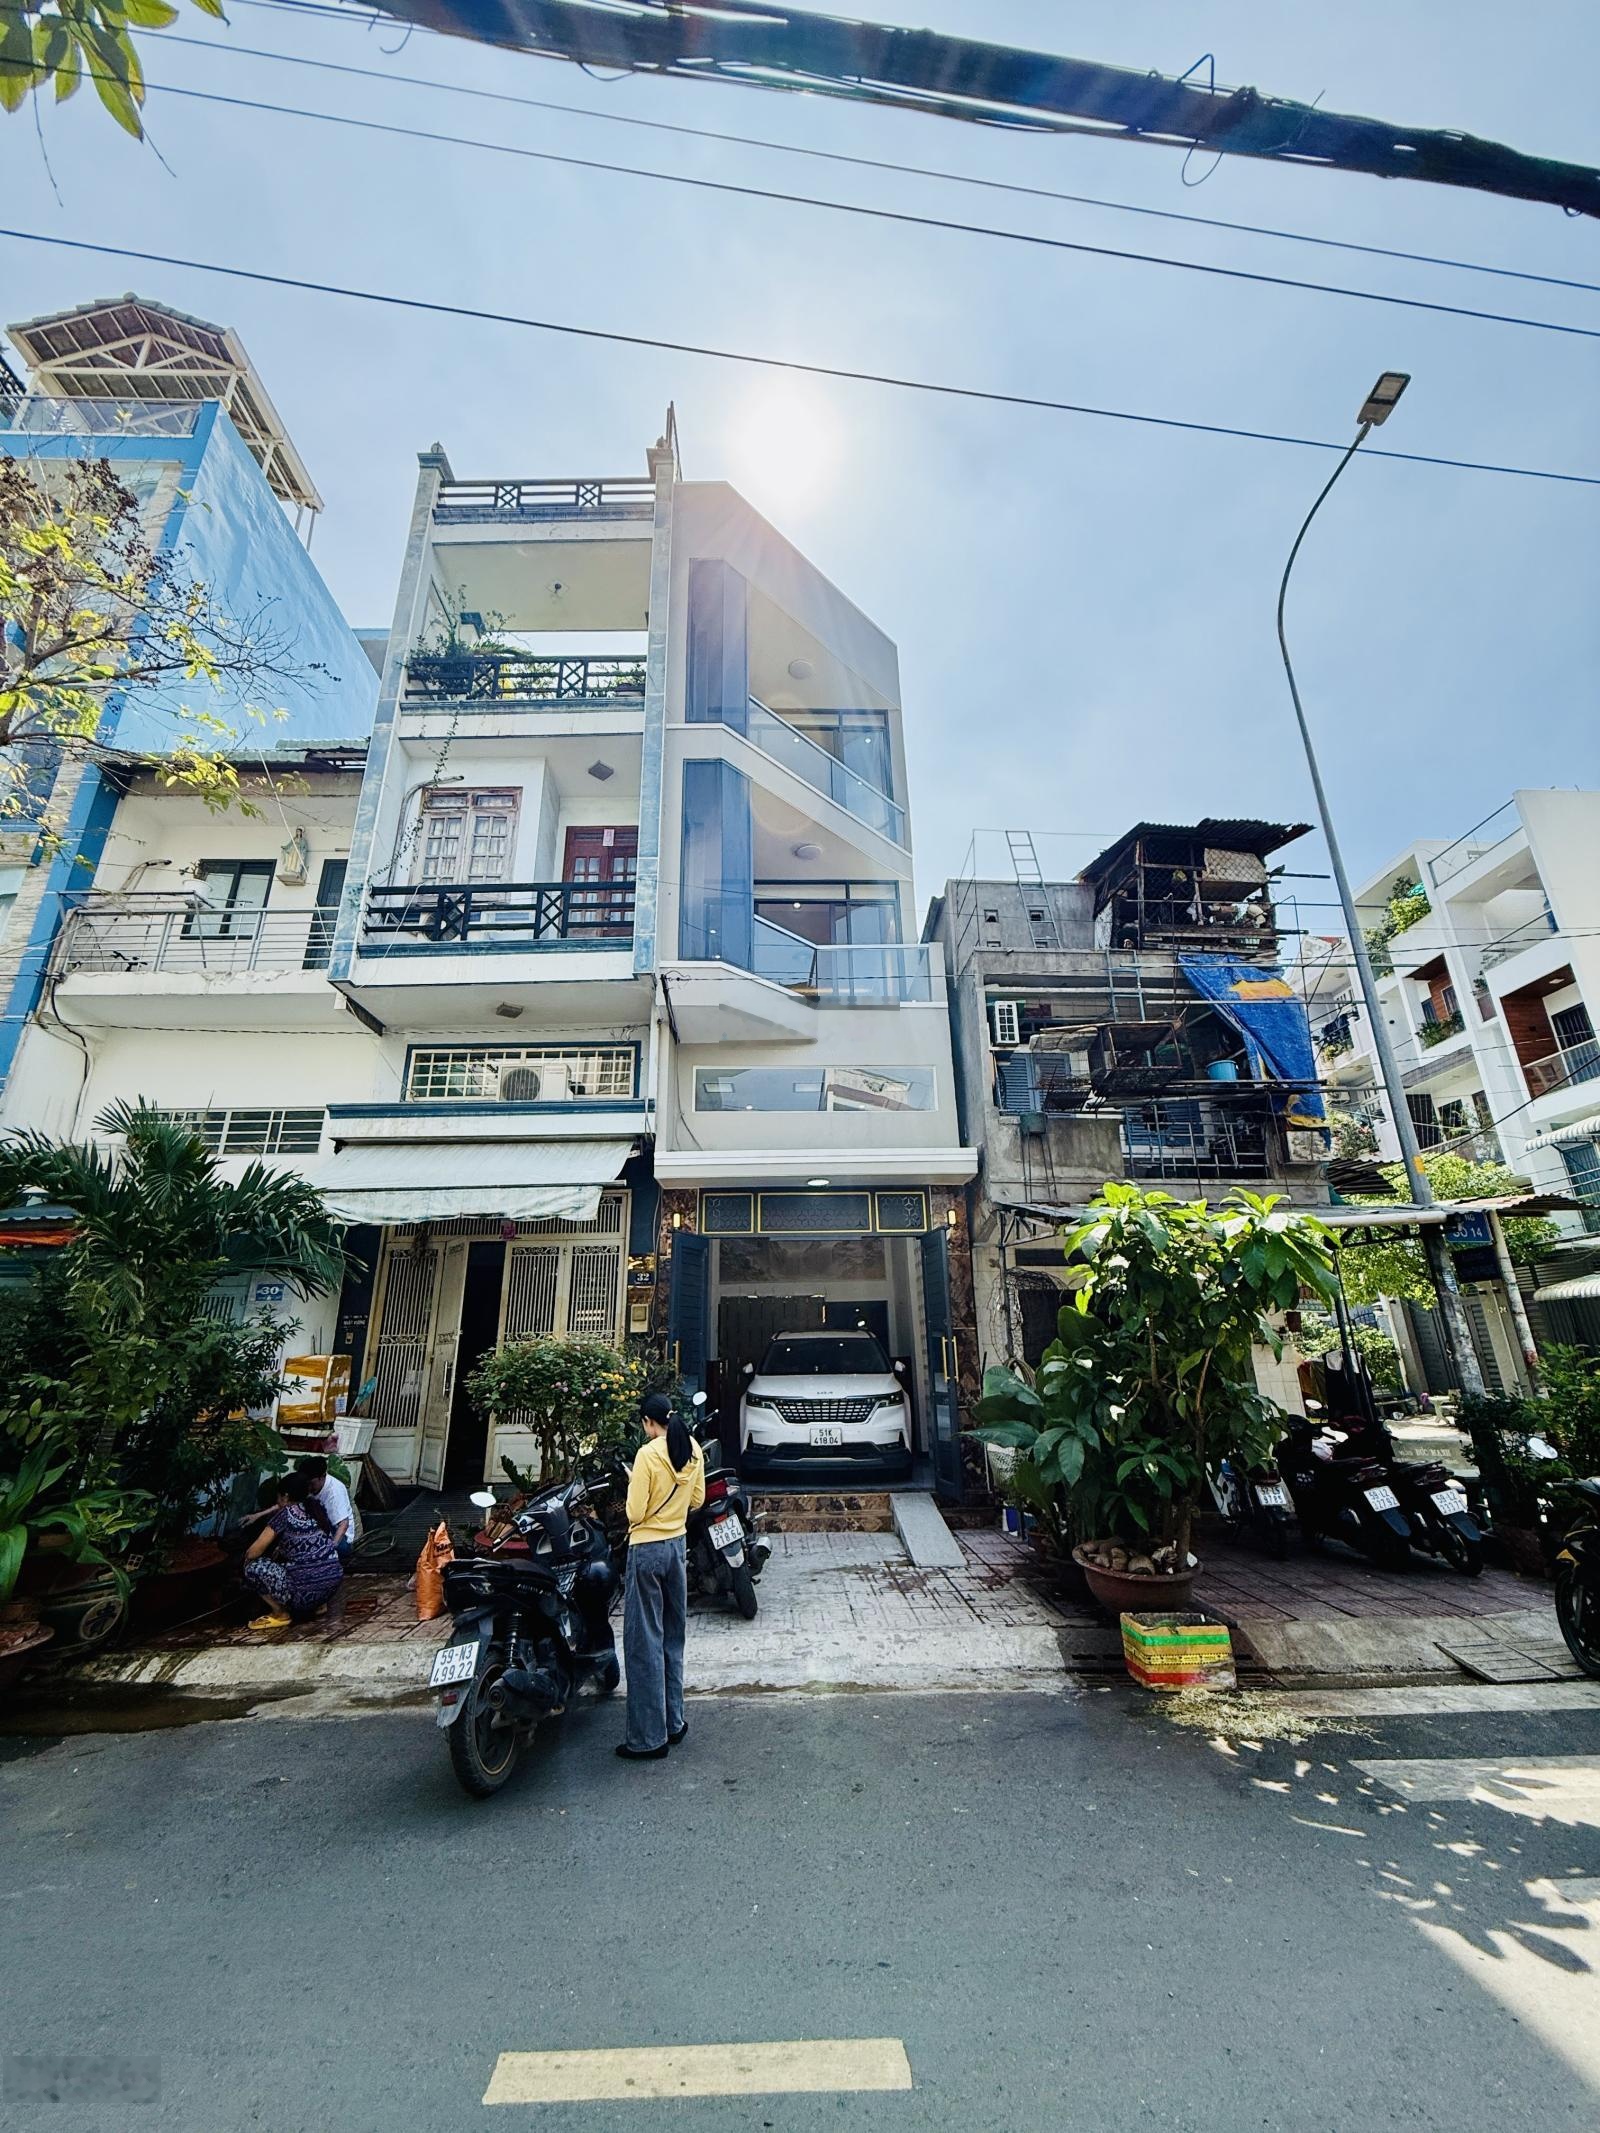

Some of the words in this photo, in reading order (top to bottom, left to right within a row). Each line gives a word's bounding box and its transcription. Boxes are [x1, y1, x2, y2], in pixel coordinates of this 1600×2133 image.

[1471, 1227, 1483, 1238] 14
[636, 1272, 650, 1282] 32
[260, 1286, 280, 1295] 30
[713, 1518, 736, 1536] 59-L2
[440, 1644, 474, 1666] 59-N3
[433, 1660, 473, 1684] 499.22
